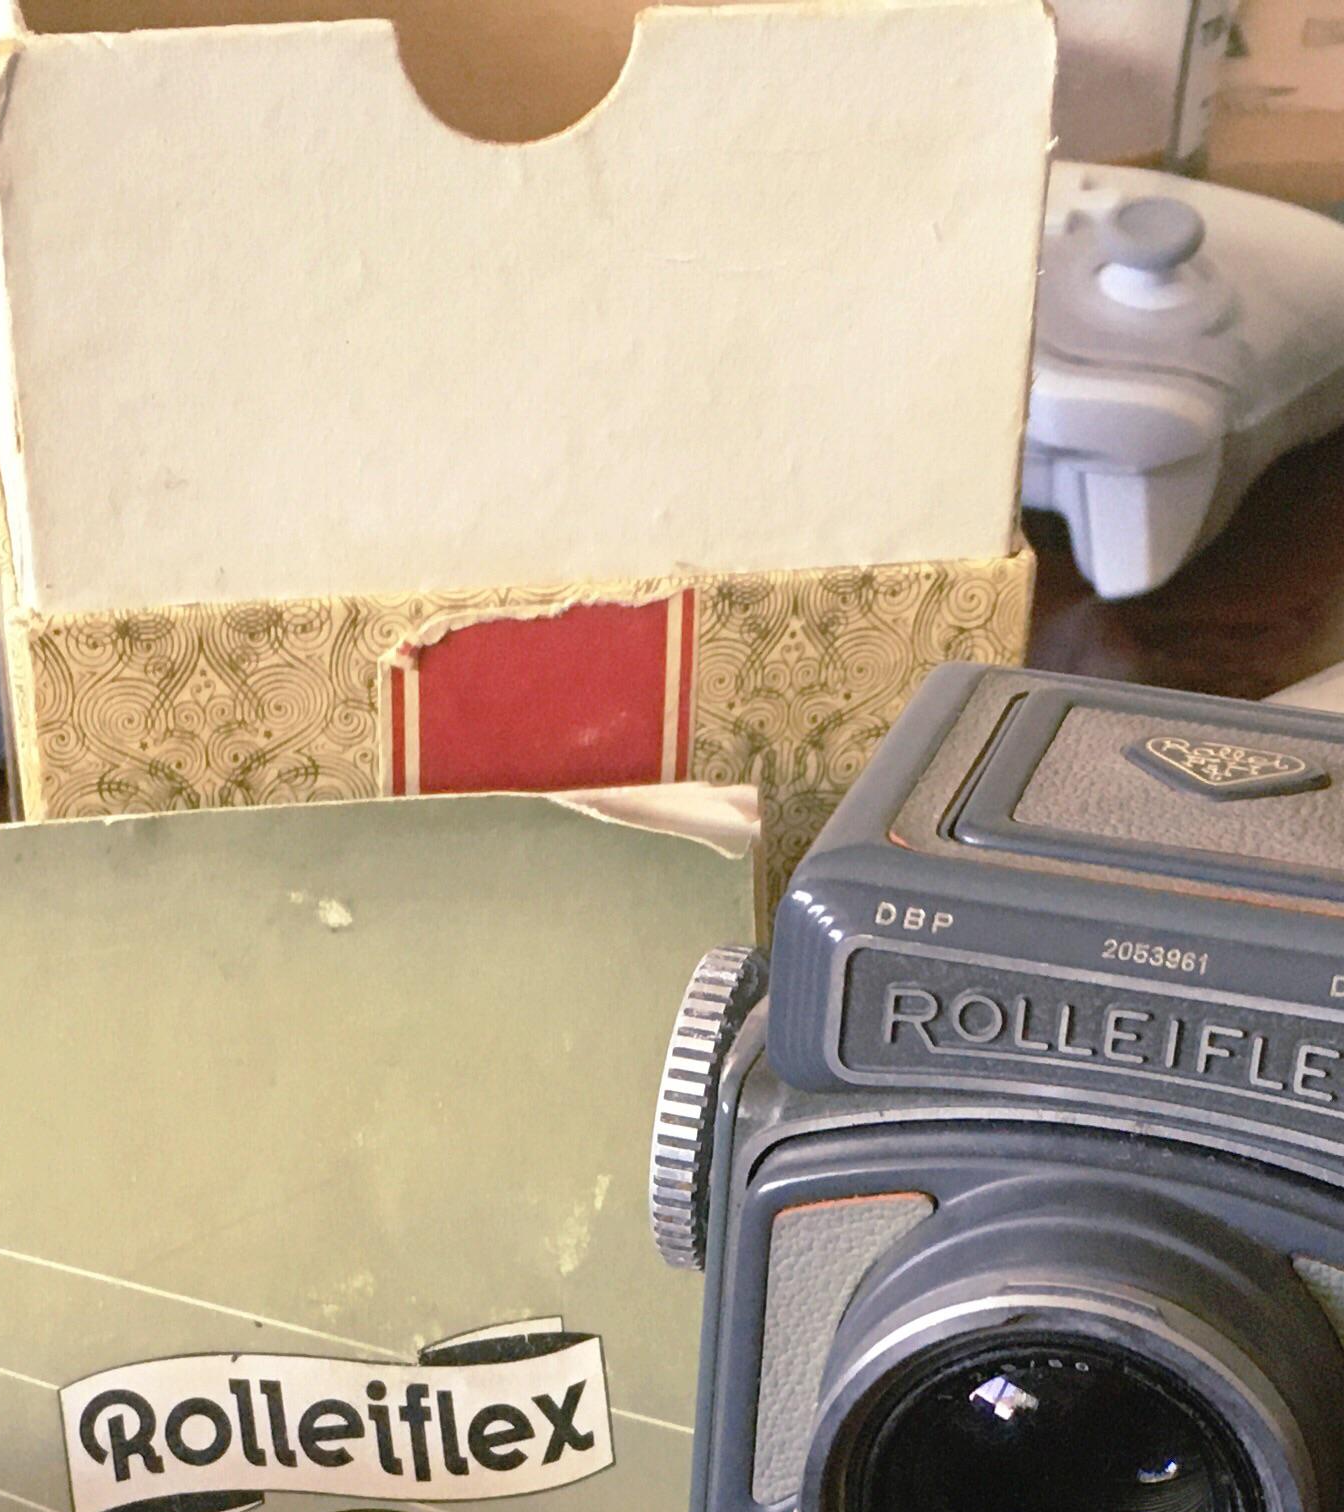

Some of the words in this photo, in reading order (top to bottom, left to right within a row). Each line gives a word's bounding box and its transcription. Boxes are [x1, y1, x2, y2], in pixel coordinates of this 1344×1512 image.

[873, 901, 955, 934] DBP
[1101, 938, 1210, 976] 2053961
[79, 1378, 596, 1483] Rolleiflex
